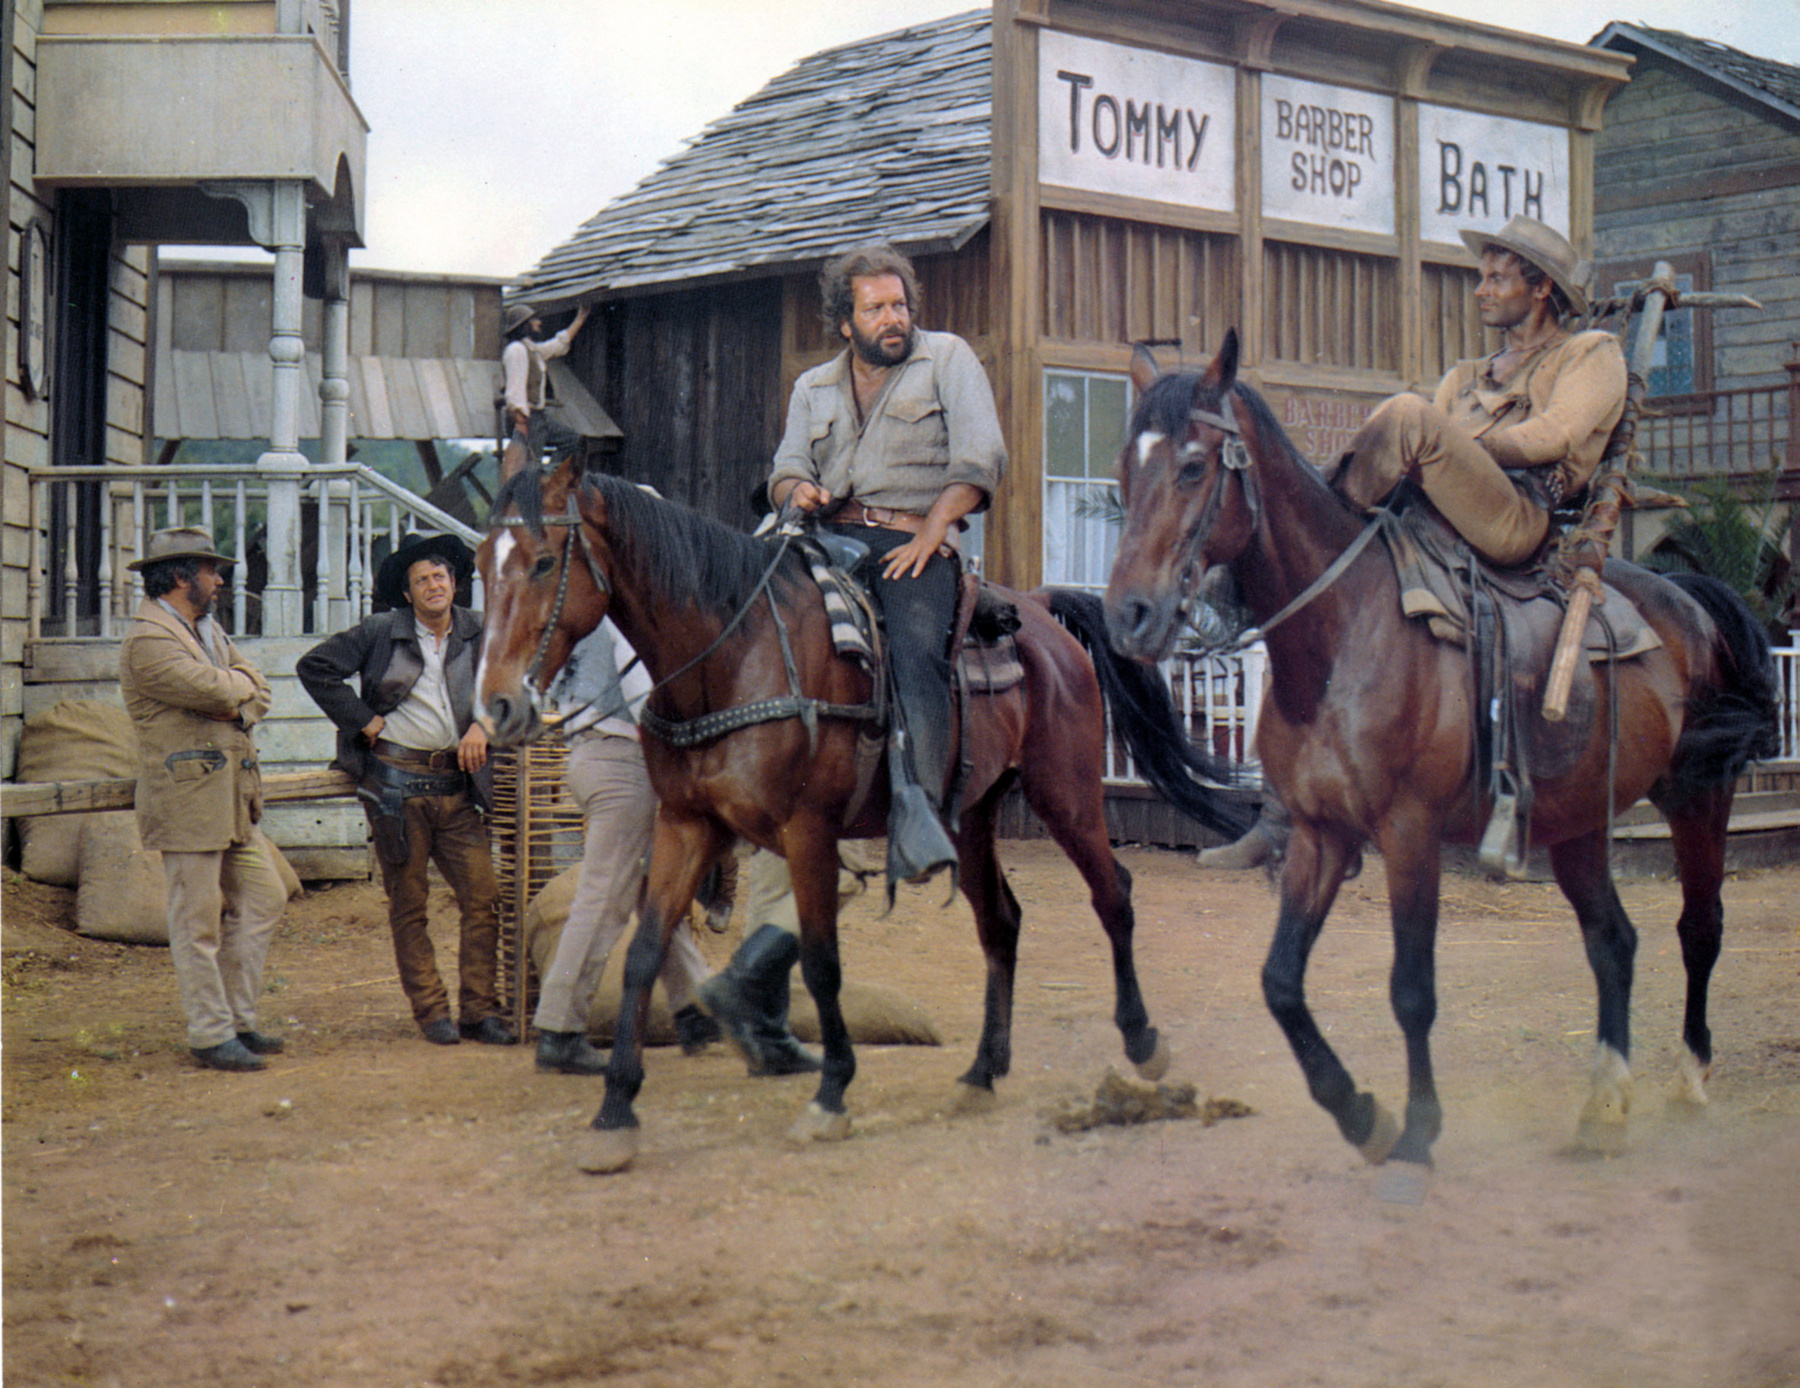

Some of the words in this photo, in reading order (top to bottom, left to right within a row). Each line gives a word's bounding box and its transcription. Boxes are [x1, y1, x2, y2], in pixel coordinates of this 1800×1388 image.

[1056, 69, 1209, 172] TOMMY
[1275, 98, 1376, 161] BARBER
[1291, 150, 1362, 198] SHOP
[1436, 138, 1543, 220] BATH
